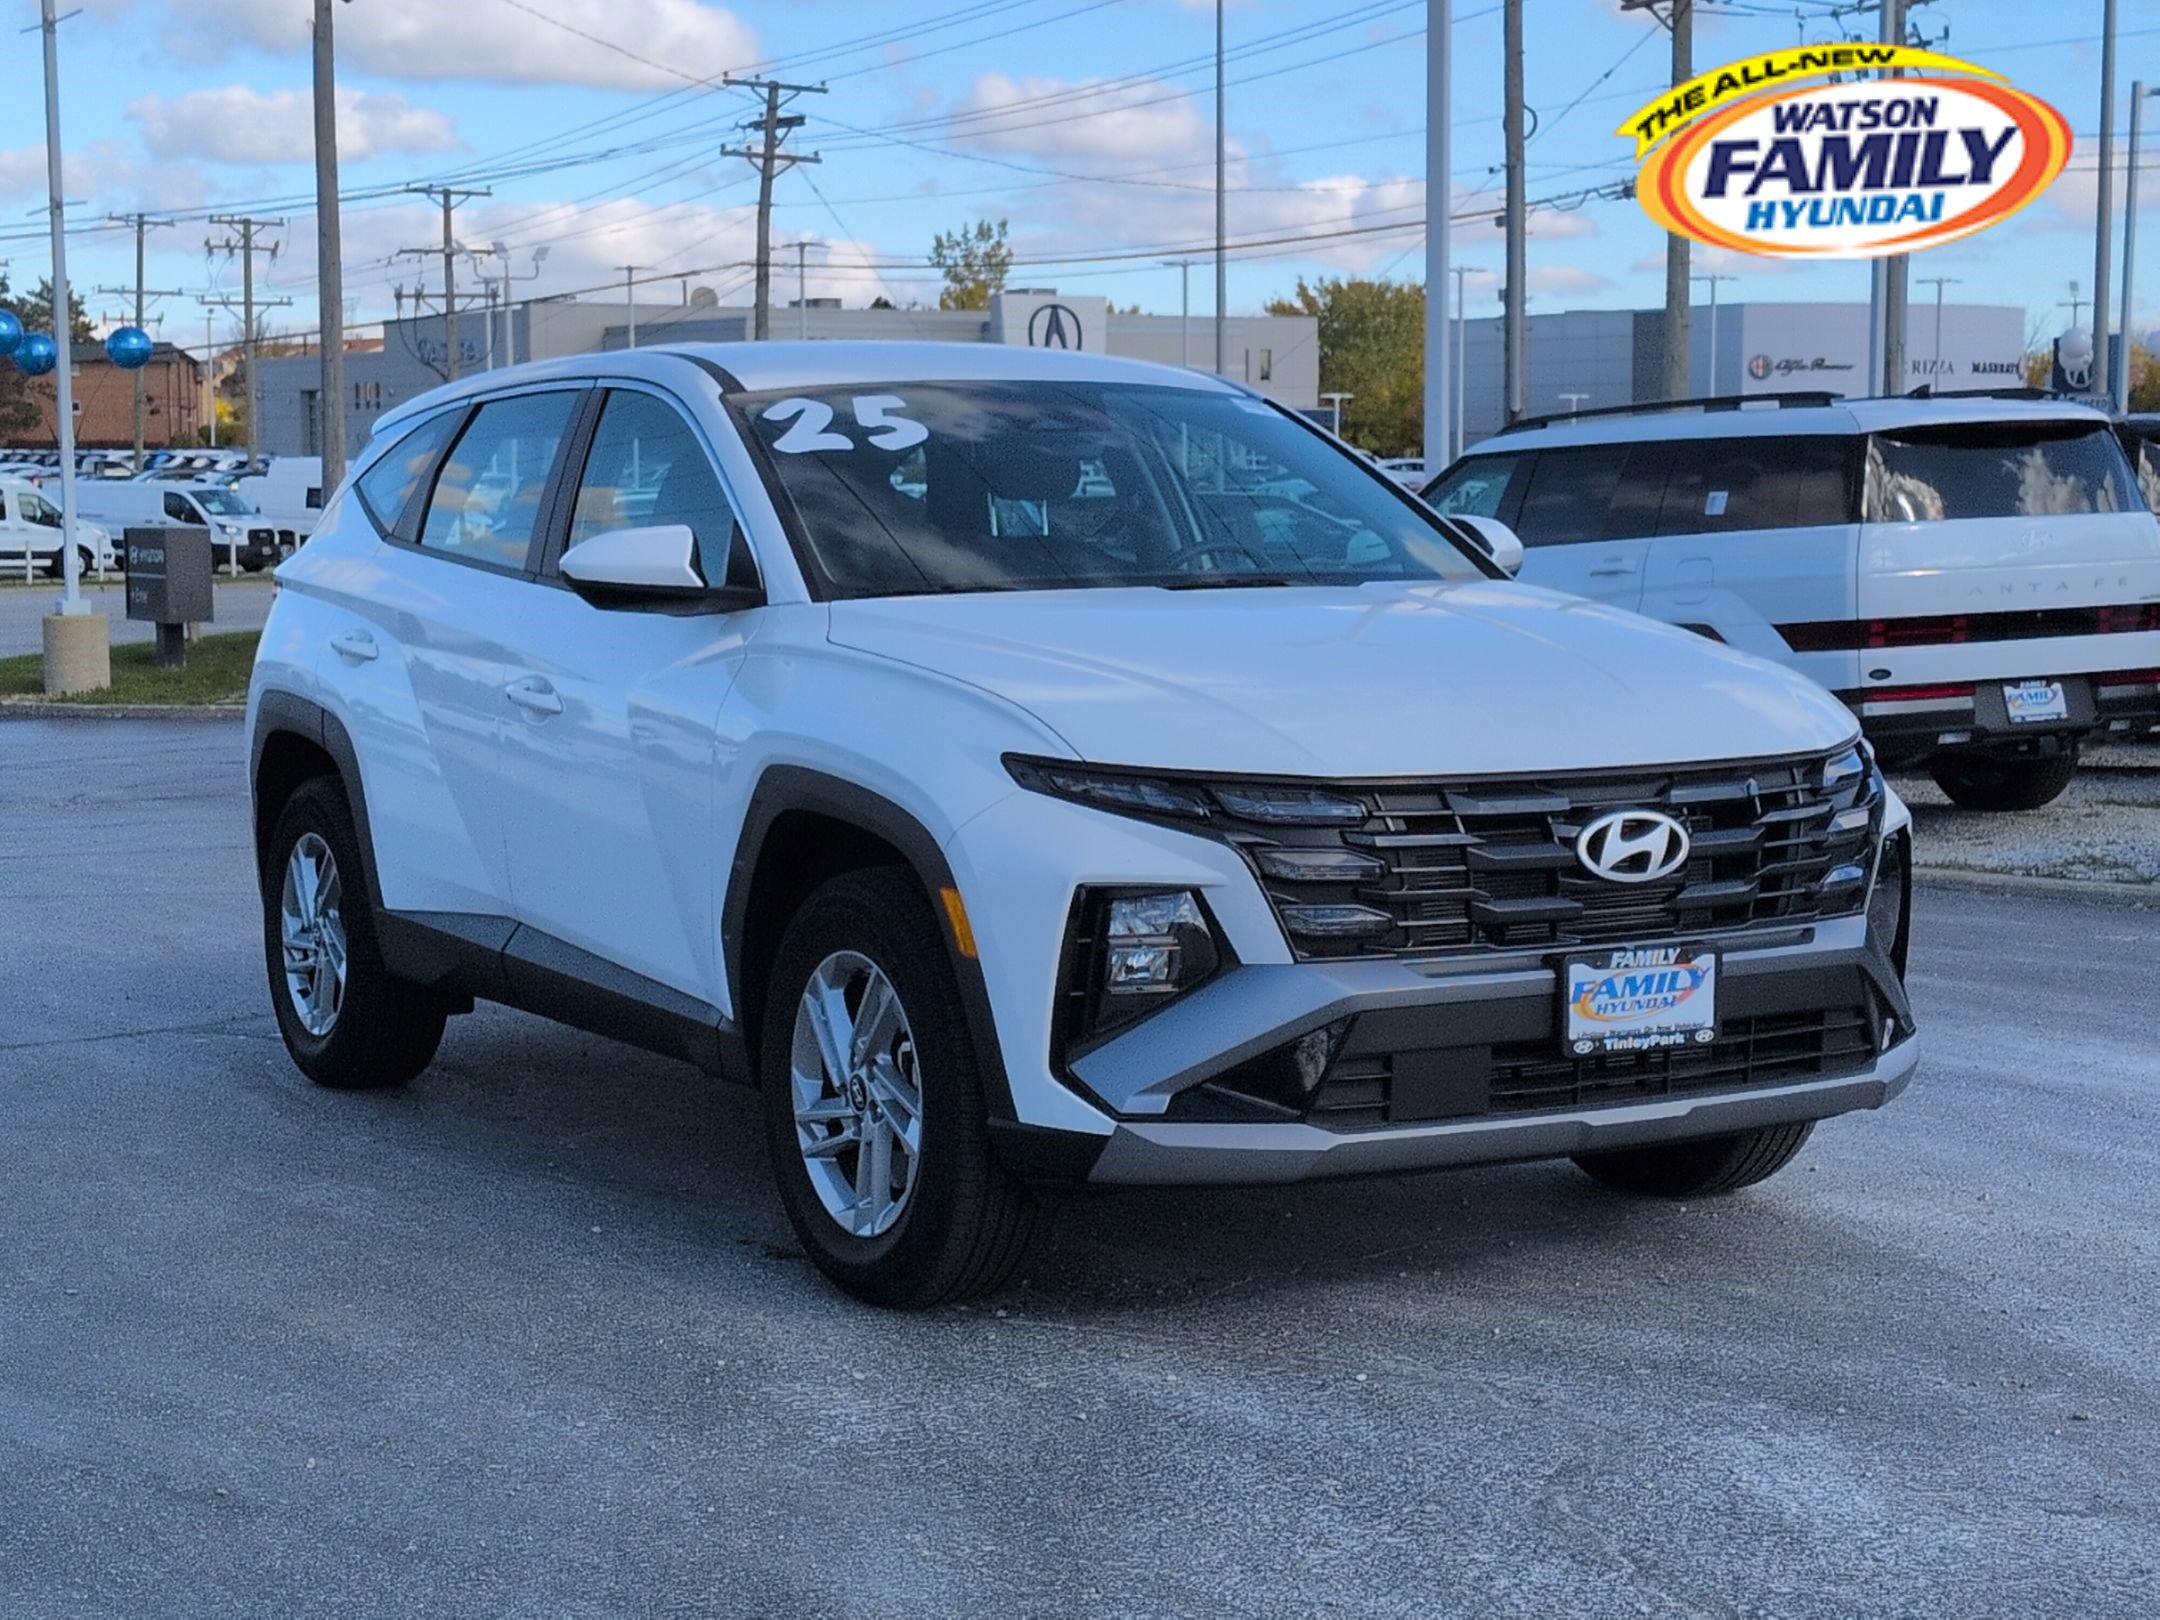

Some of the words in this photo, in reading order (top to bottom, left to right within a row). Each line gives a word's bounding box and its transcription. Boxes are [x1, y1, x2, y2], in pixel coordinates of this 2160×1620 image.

[761, 394, 930, 454] 25
[1610, 947, 1682, 969] FAMILY
[1571, 966, 1713, 1005] FAMILY
[1595, 995, 1679, 1015] HYUNDAI
